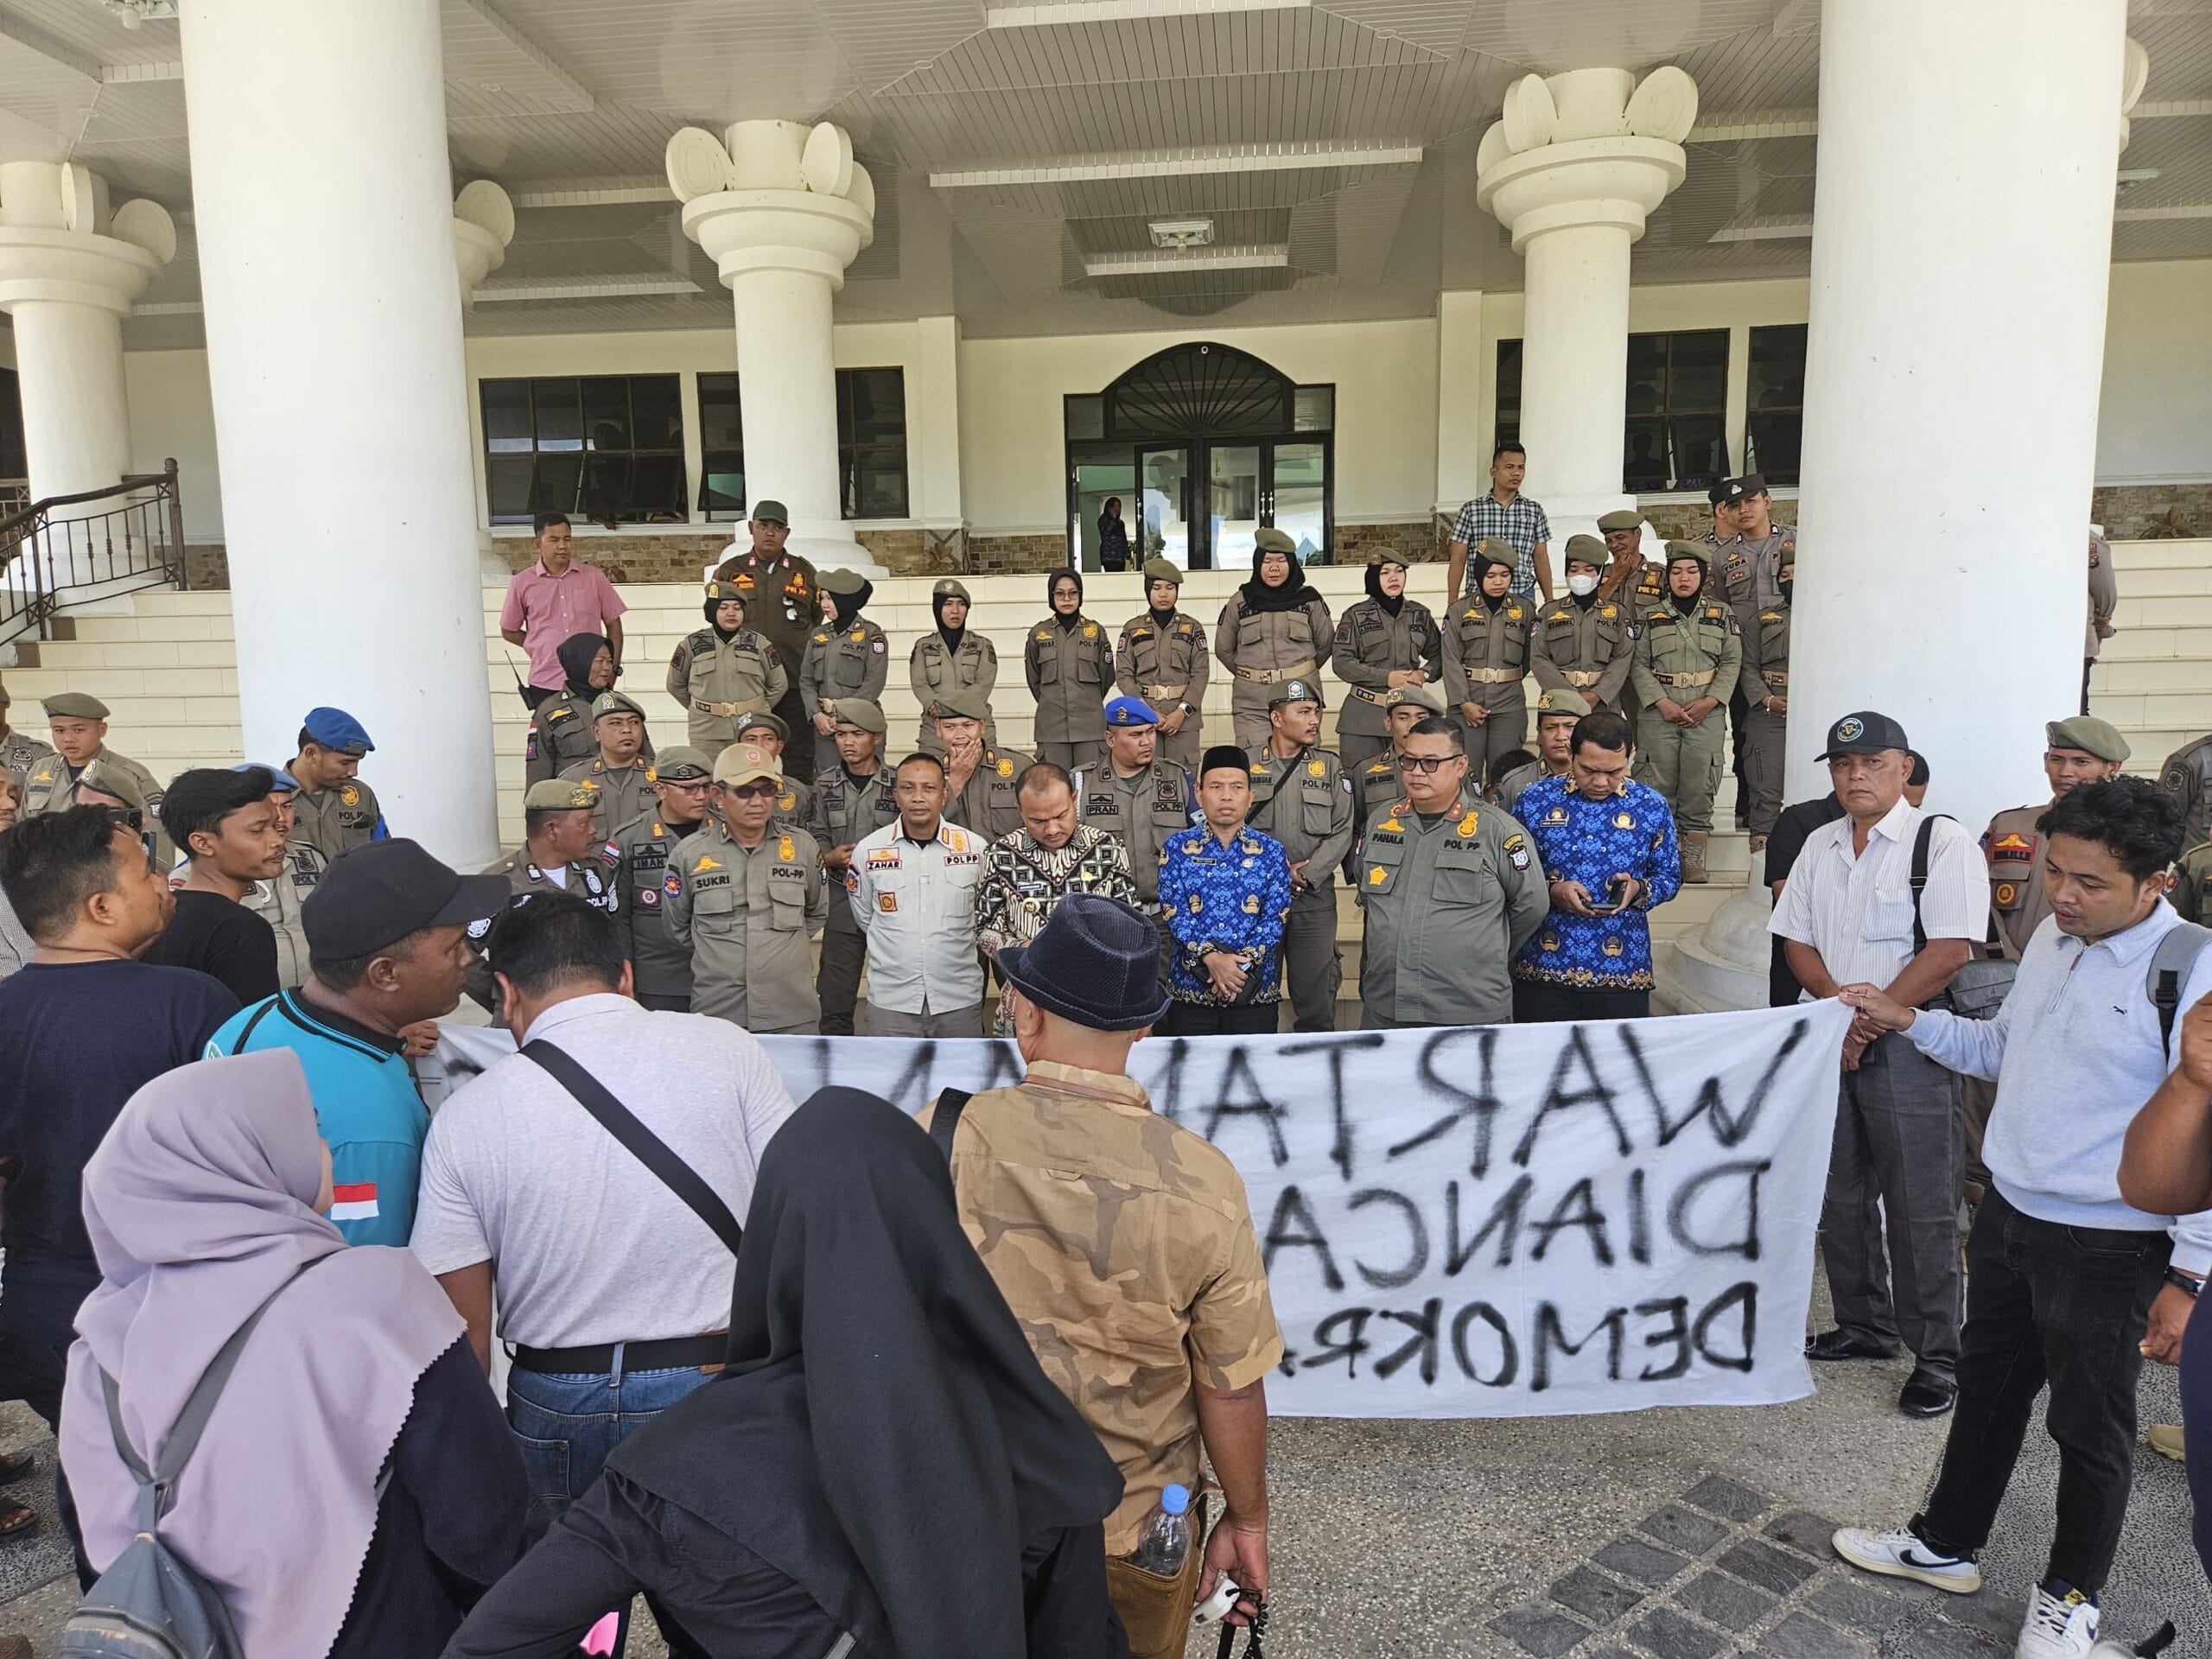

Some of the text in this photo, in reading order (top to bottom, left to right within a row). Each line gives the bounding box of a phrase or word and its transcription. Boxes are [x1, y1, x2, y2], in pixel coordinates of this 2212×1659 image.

[1724, 559, 1746, 571] TUDA
[1302, 779, 1319, 788] POL
[338, 810, 355, 820] POL
[1372, 833, 1404, 845] PAHALA
[1444, 839, 1480, 850] POL PP
[868, 861, 899, 870] ZAHAR
[772, 868, 804, 880] POL-PP
[696, 874, 730, 888] SUKRI
